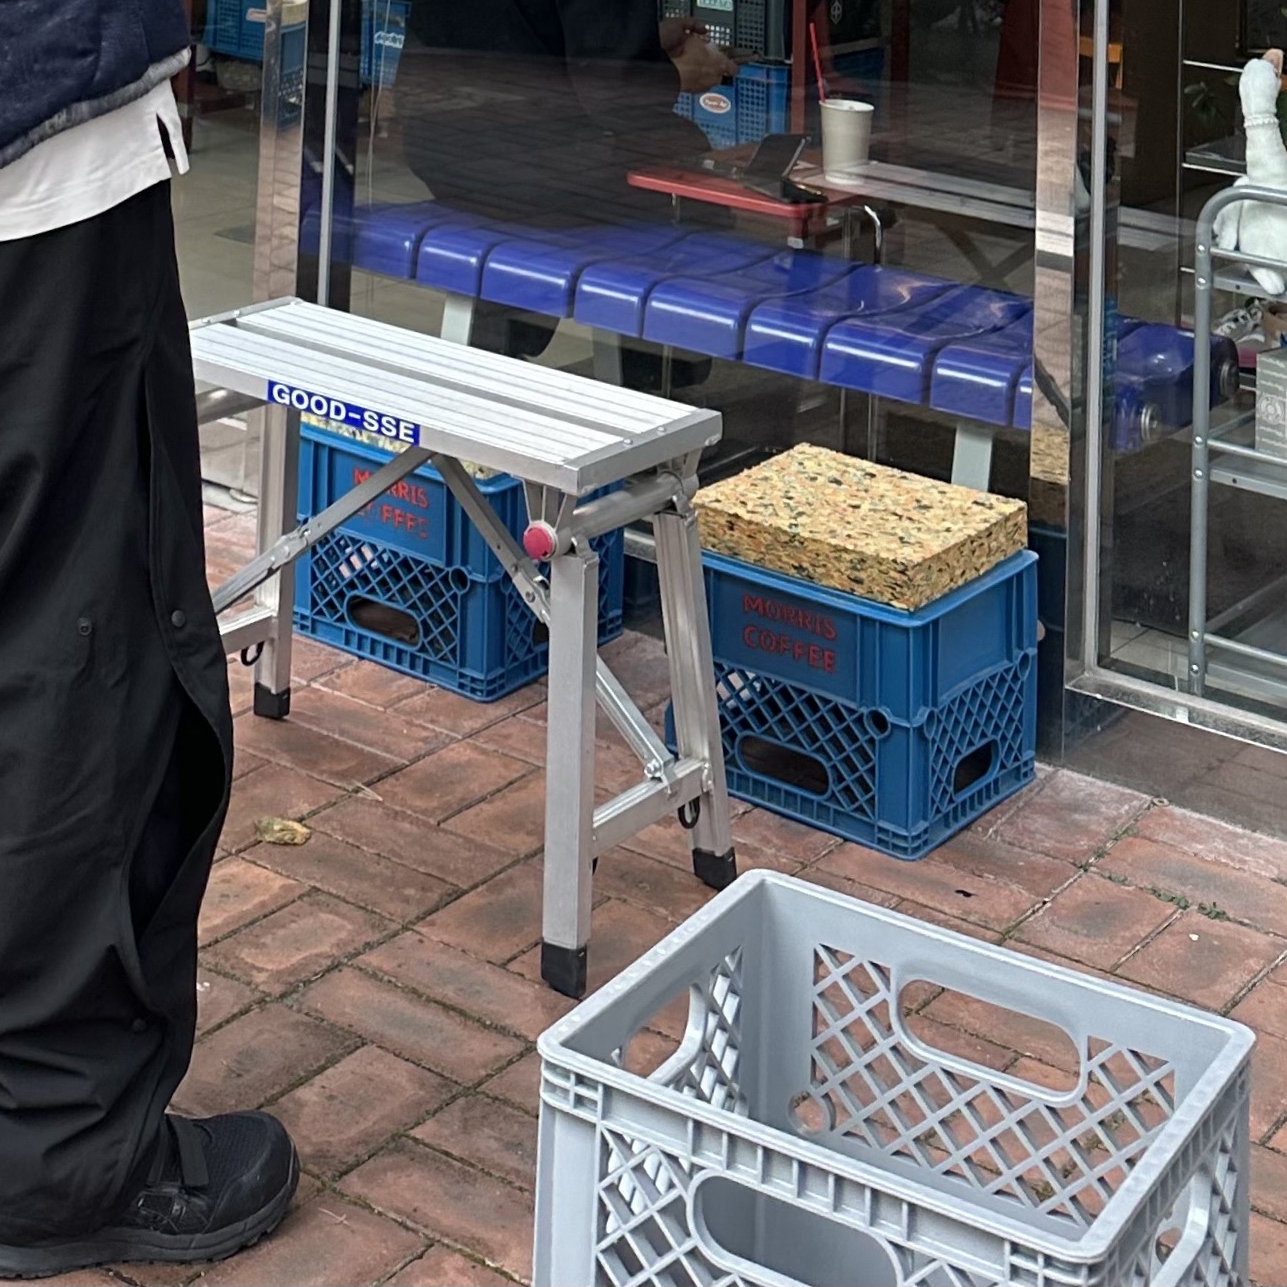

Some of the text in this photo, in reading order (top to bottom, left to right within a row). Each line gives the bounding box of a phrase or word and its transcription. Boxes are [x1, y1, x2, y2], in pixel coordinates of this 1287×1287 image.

[271, 383, 416, 444] GOOD-SSE
[353, 467, 429, 509] MRRIS
[742, 592, 838, 641] MORRIS
[743, 623, 837, 675] COFFEE
